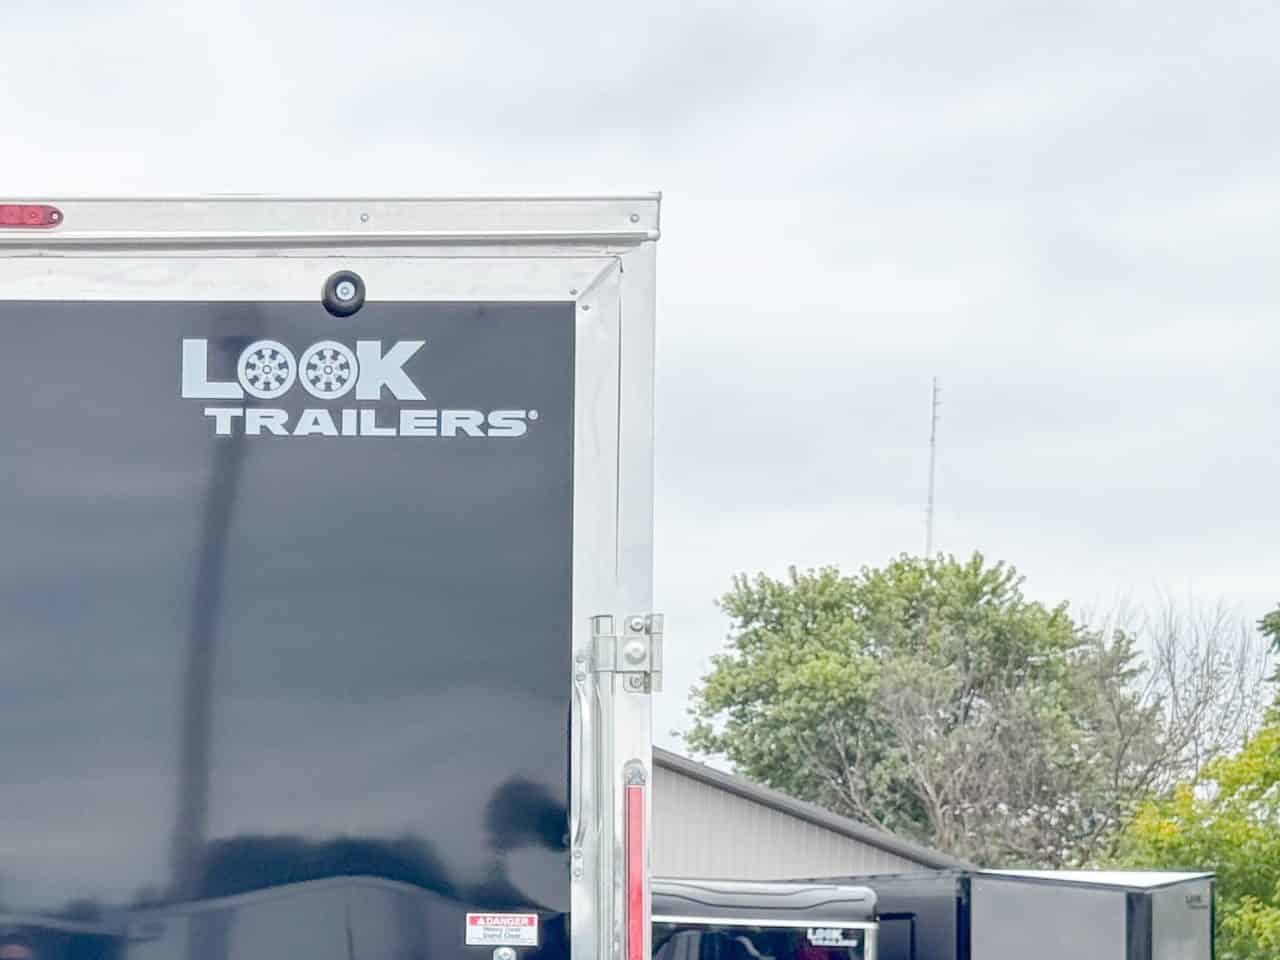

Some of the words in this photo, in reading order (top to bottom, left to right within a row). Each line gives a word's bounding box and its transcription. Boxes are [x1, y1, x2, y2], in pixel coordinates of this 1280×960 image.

[181, 338, 427, 401] LOOK
[204, 407, 528, 437] TRAILERS
[486, 917, 528, 927] DANGER
